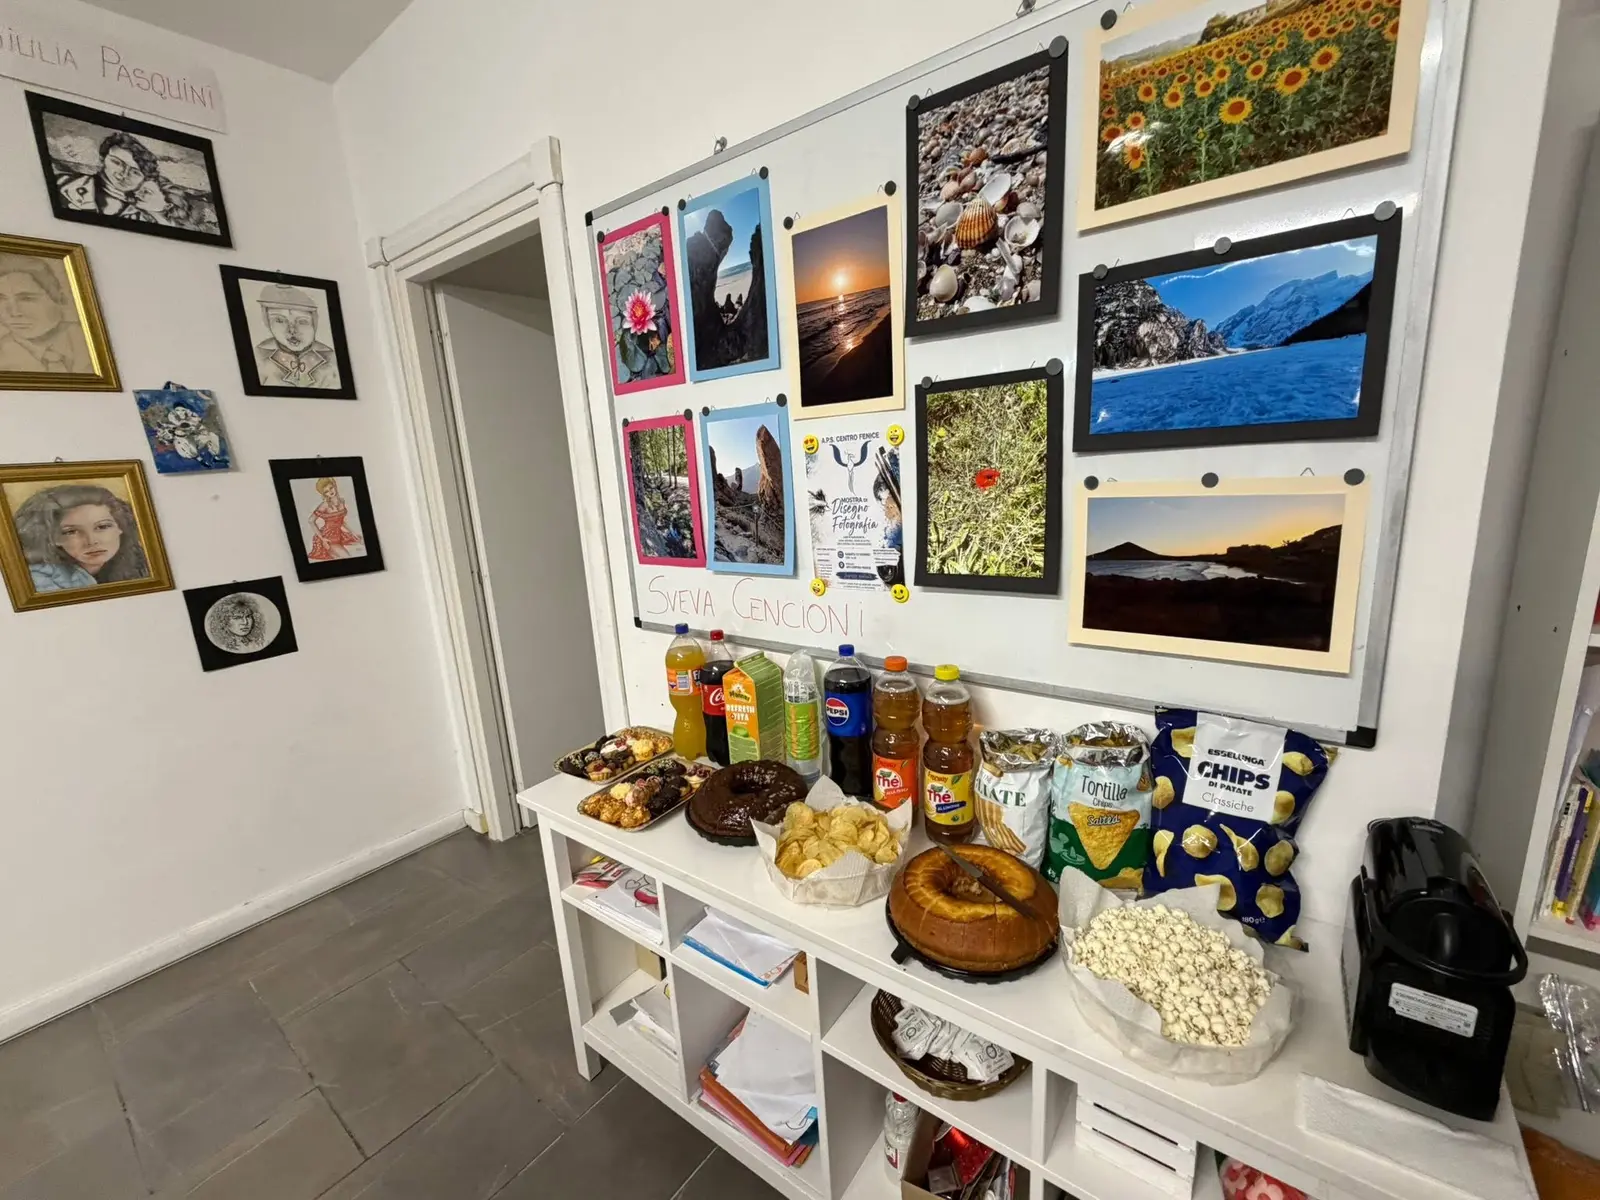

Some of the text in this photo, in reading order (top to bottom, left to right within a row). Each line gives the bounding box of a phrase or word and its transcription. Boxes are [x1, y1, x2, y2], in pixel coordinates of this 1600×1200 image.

[0, 27, 78, 70] IULIA
[836, 434, 858, 442] CENTRO
[859, 431, 880, 440] FENICE
[832, 497, 870, 520] Disegno
[832, 515, 879, 536] Fotografia
[647, 575, 715, 617] SVEVA
[826, 706, 848, 717] PEPSI
[1197, 760, 1272, 791] CHIPS
[1081, 775, 1129, 801] Tortilla
[1208, 780, 1253, 797] DI PATATE
[1201, 791, 1255, 813] Classiche
